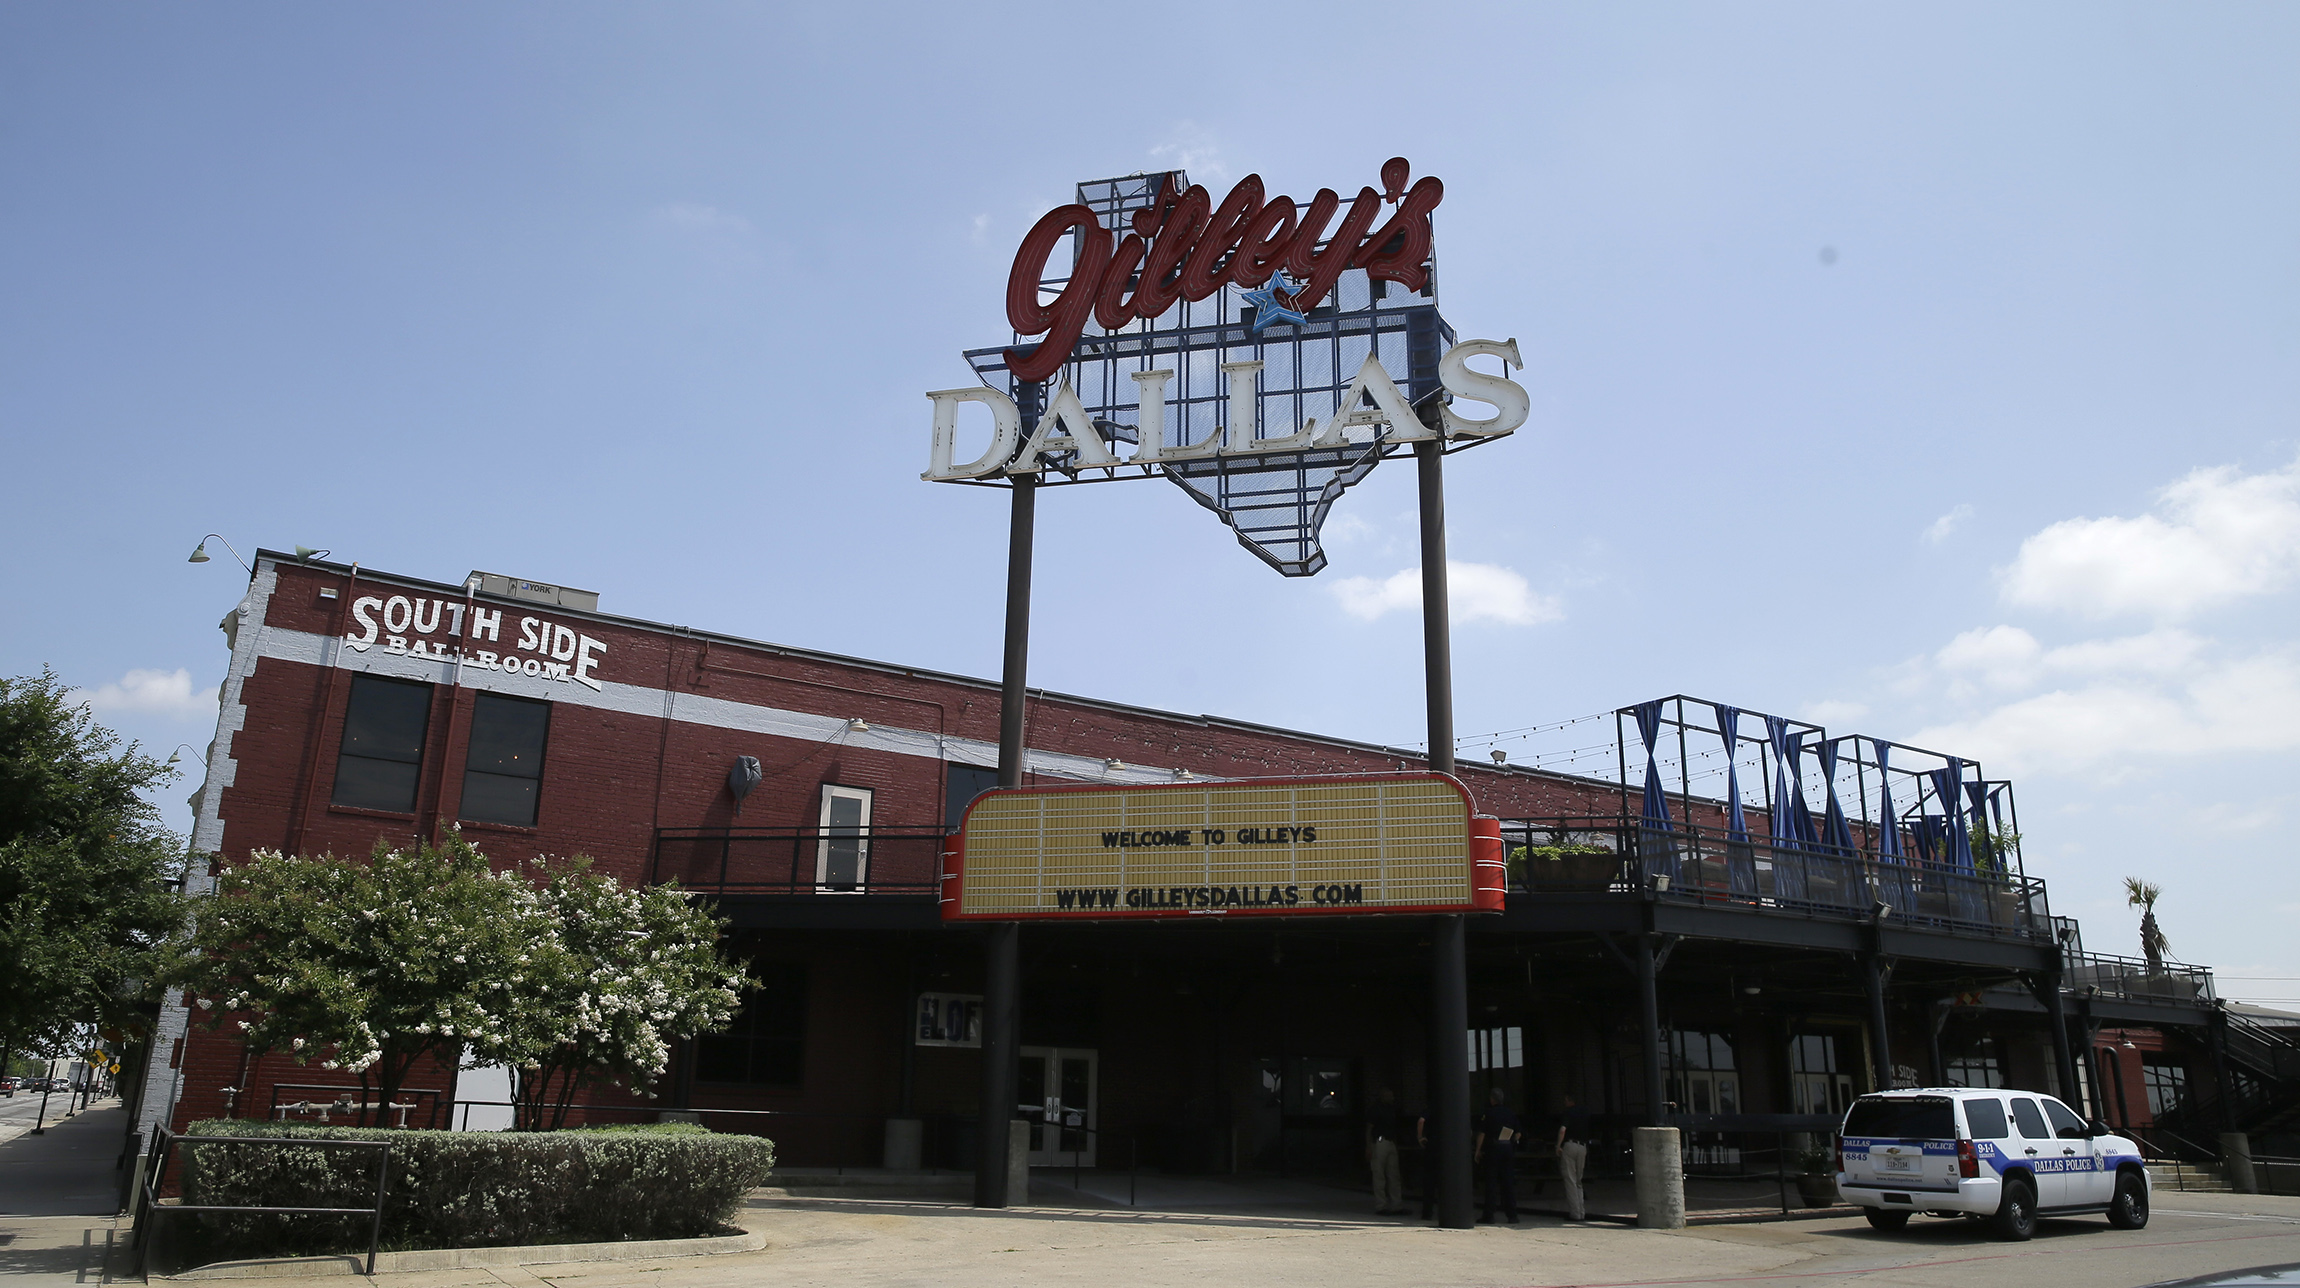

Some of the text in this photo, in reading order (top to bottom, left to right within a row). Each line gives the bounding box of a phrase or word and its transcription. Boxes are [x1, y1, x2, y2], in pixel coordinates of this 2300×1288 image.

[920, 337, 1531, 482] DALLAS
[528, 584, 552, 595] YORK
[345, 595, 608, 692] SOUTH SIDE
[383, 634, 571, 683] BALLROOM
[1101, 826, 1317, 848] WELCOME TO GILLEYS
[1312, 884, 1362, 904] COM
[930, 998, 984, 1042] LOF
[1898, 1065, 1919, 1088] SIDE
[1845, 1152, 1868, 1161] 8845
[1923, 1142, 1955, 1150] POLICE
[2034, 1159, 2092, 1172] DALLAS POLICE
